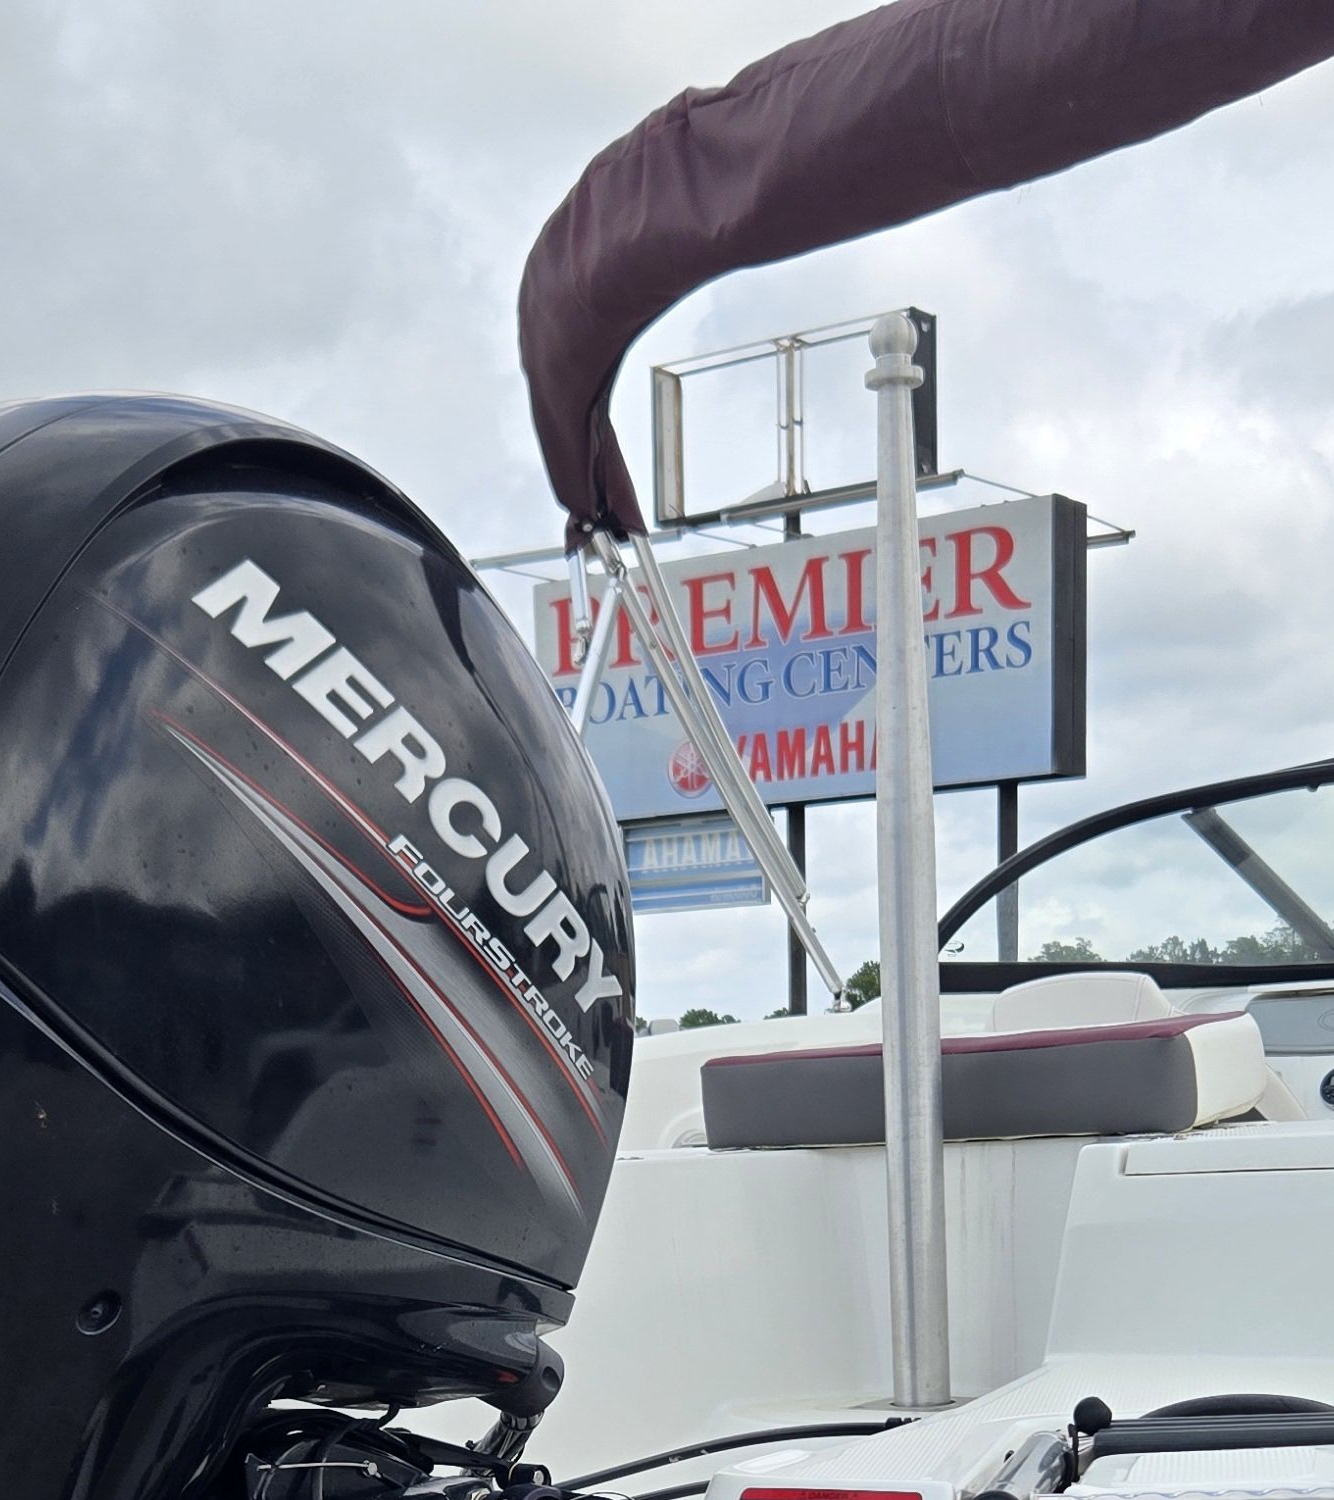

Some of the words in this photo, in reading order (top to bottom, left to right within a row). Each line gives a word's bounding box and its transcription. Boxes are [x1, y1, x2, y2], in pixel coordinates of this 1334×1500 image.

[557, 658, 774, 725] BOATNG
[782, 620, 1033, 698] CENERS
[735, 718, 877, 784] AMAH
[190, 558, 624, 1013] MERCURY
[388, 833, 595, 1081] FOURSTROKE
